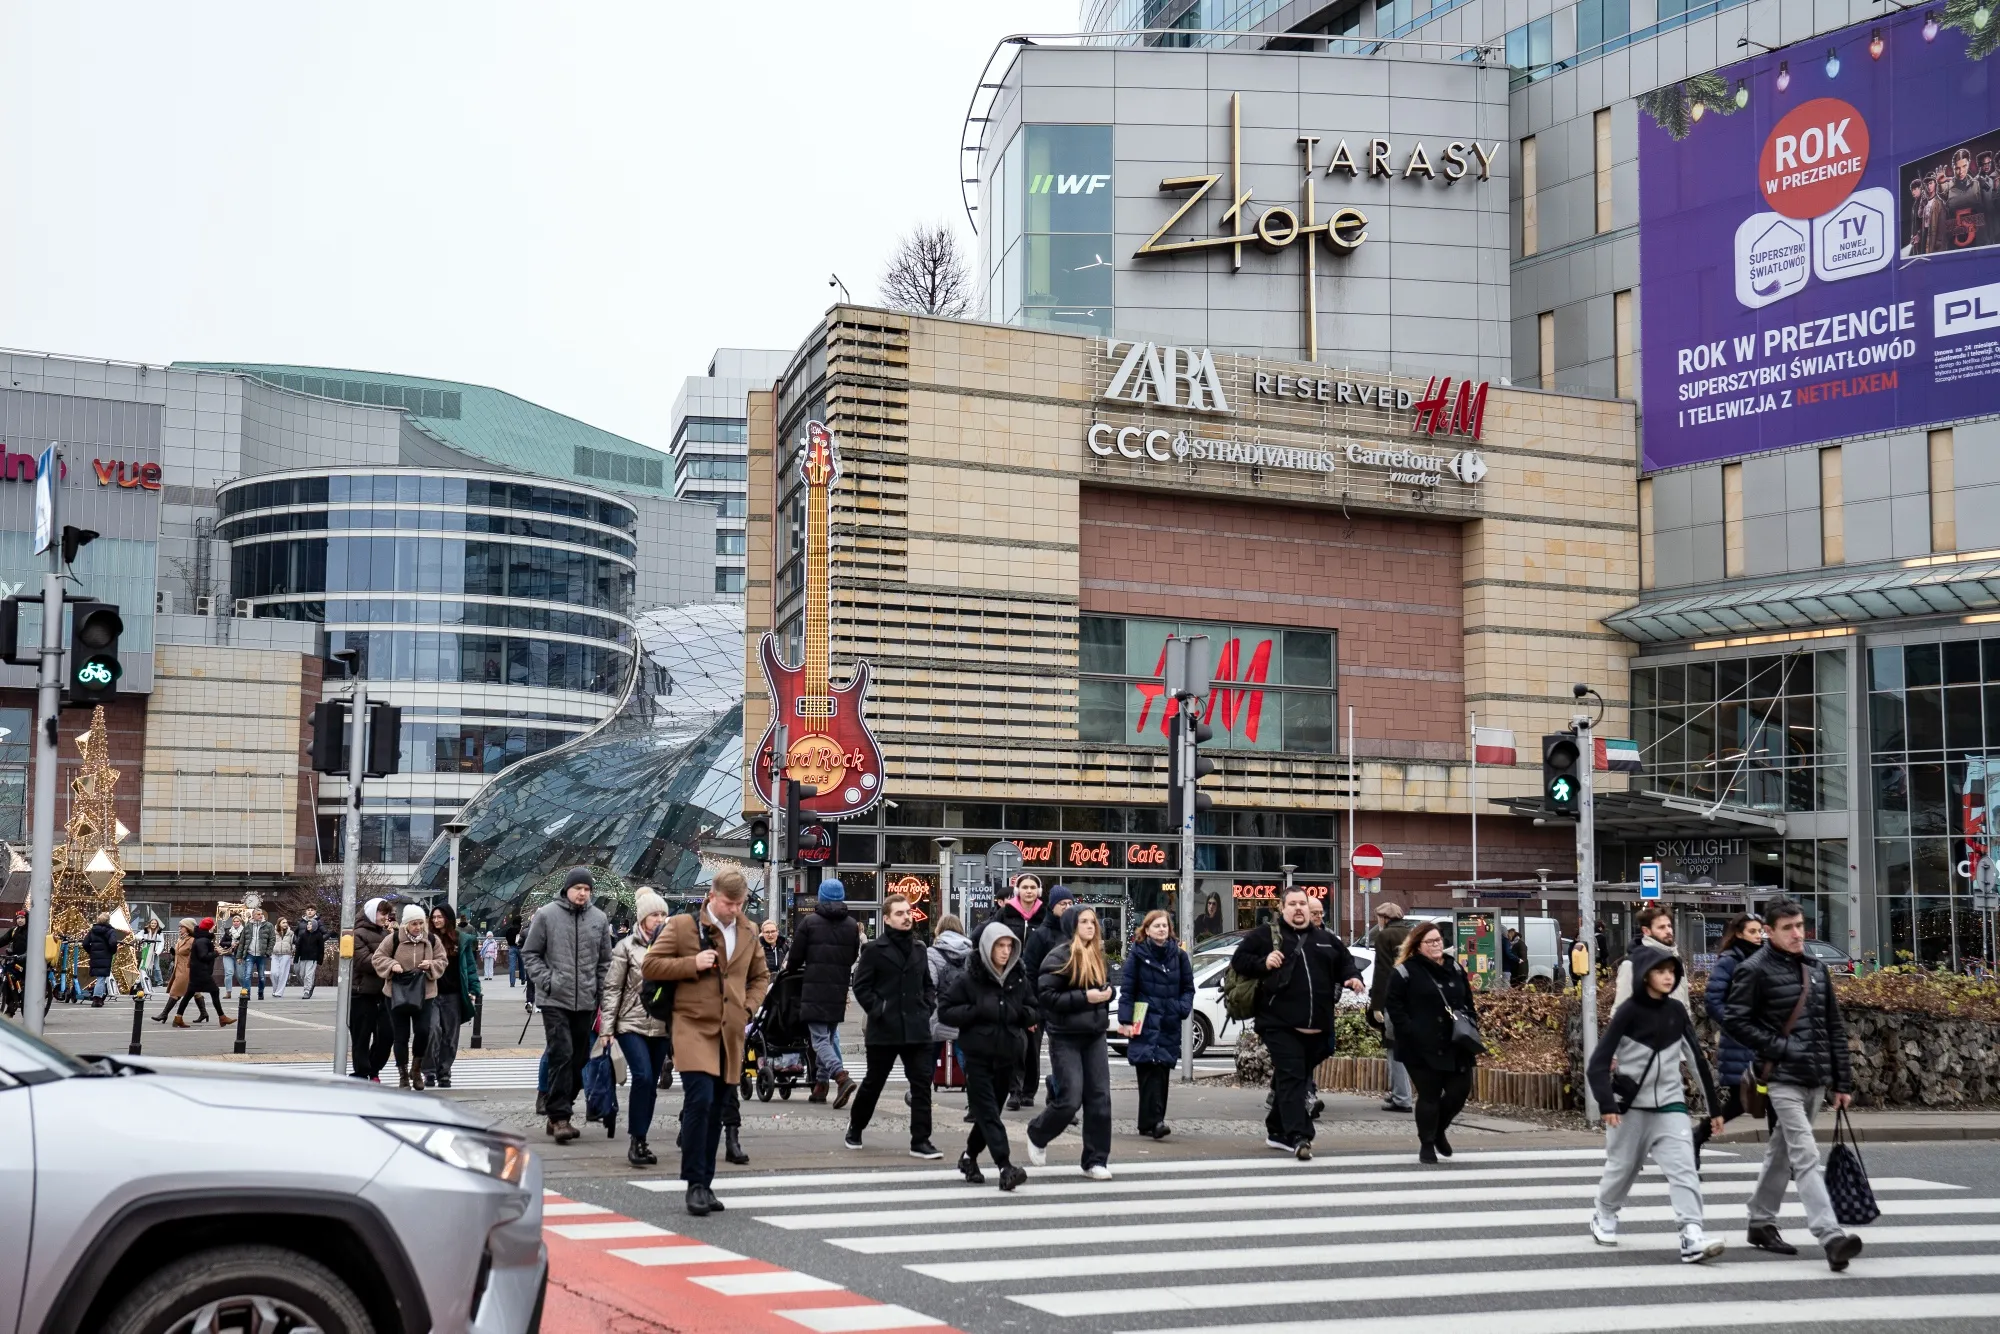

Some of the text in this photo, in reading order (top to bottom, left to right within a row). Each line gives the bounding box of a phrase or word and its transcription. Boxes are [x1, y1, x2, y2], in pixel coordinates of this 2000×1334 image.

[1297, 135, 1501, 184] TARASY
[1775, 118, 1851, 173] ROK
[1766, 156, 1862, 195] W PREZENCIE
[1132, 91, 1368, 361] Złote
[1839, 214, 1867, 239] TV
[1749, 243, 1806, 265] SUPERSZYBKI
[1832, 247, 1875, 263] GENERACJI
[1839, 238, 1867, 251] NOWEJ
[1750, 255, 1806, 280] ŚWIATŁOWÓD
[1945, 297, 2000, 325] PL
[1678, 301, 1915, 375] ROK W PREZENCIE
[1103, 338, 1236, 412] ZARA
[1678, 338, 1916, 401] SUPERSZYBKI ŚWIATŁOWÓD
[1254, 371, 1412, 410] RESERVED
[1679, 370, 1899, 428] I TELEWIZJA Z NETFLIXEM
[1414, 375, 1489, 441] H&M
[1088, 424, 1171, 461] CCC
[1191, 438, 1336, 472] STRADIVARIUS
[1346, 444, 1446, 473] Carrefour
[92, 458, 162, 490] vue
[1390, 470, 1442, 487] market
[816, 746, 865, 772] Rock
[802, 774, 829, 785] CAFE
[1069, 842, 1110, 866] Rock
[1127, 844, 1166, 864] Cafe
[1656, 838, 1743, 856] SKYLIGHT
[1675, 856, 1723, 867] globalworth
[888, 882, 930, 895] Hard Rock
[1233, 884, 1277, 898] ROCK
